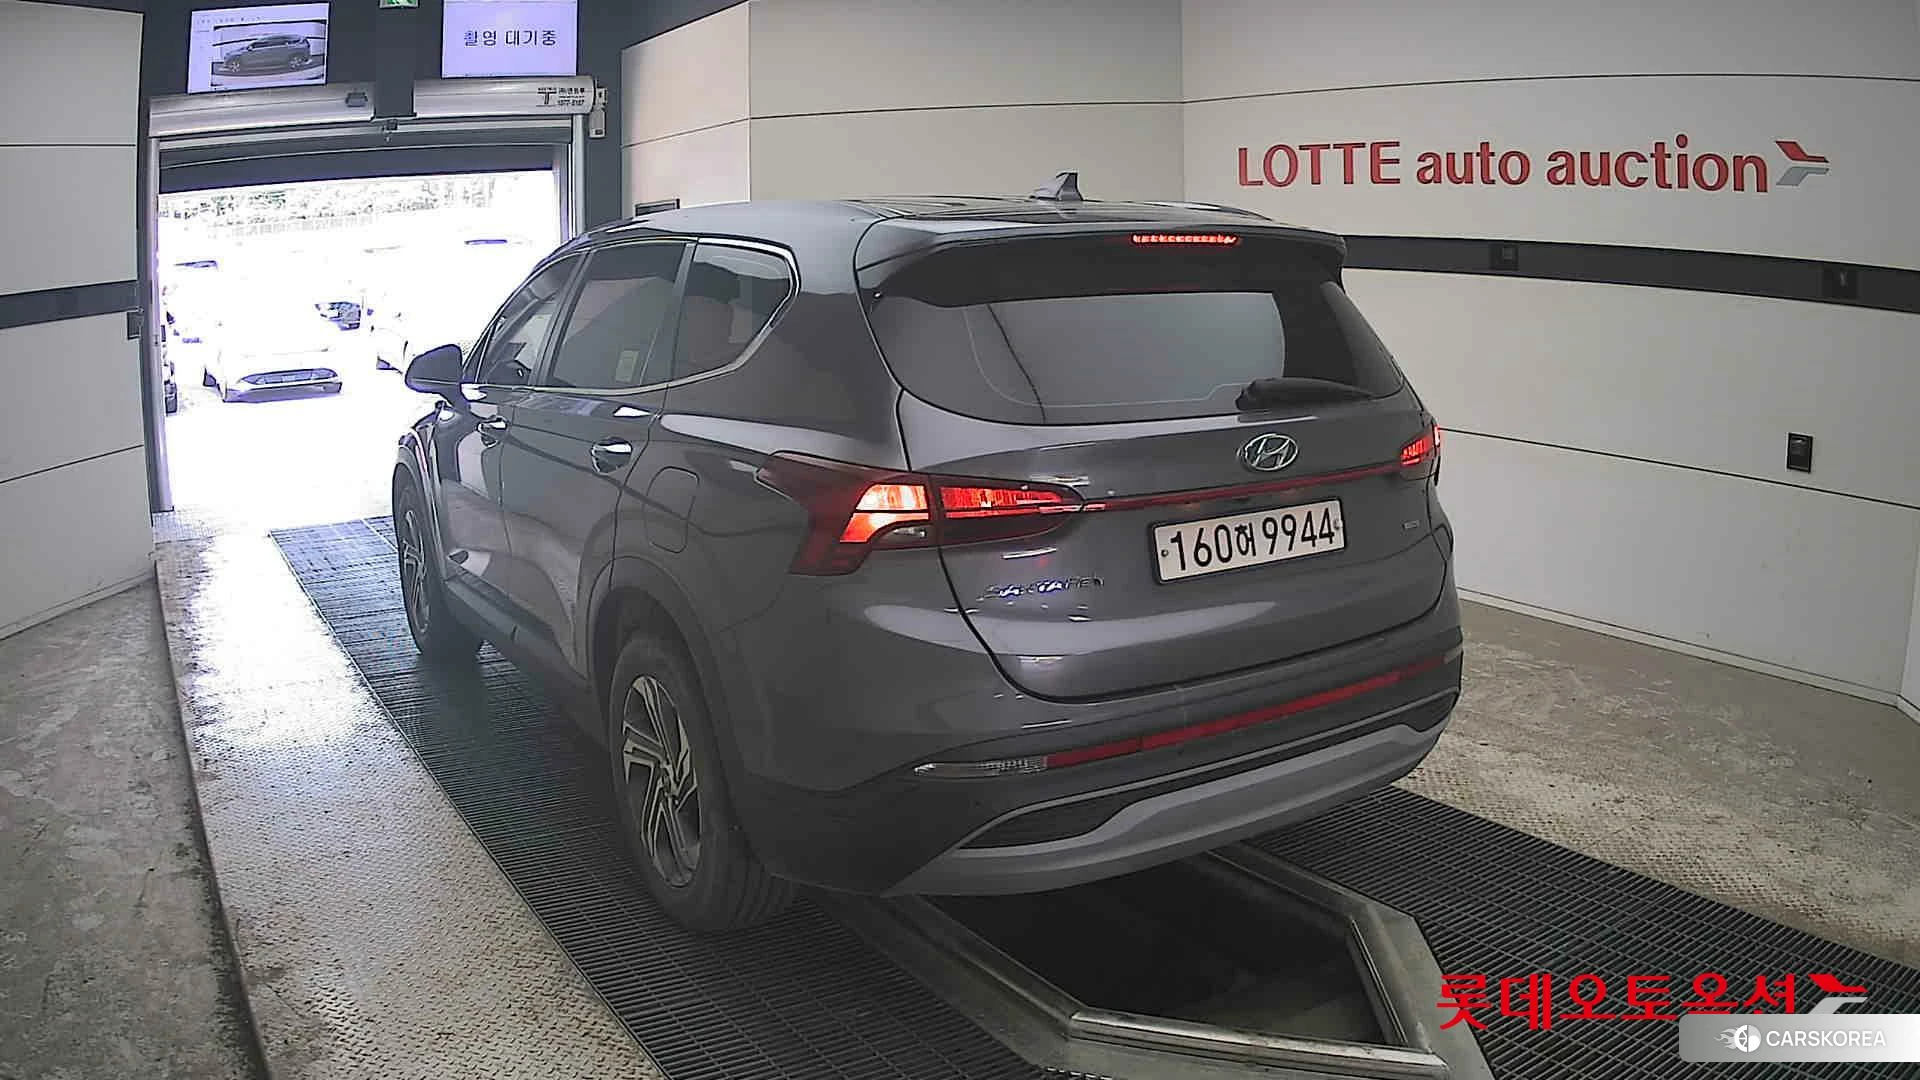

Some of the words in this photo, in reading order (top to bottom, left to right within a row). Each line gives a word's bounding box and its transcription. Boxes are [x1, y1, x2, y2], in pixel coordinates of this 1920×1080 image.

[505, 30, 556, 47] 대기중
[1238, 141, 1400, 187] LOTTE
[1417, 142, 1532, 185] auto
[1546, 134, 1768, 192] auction
